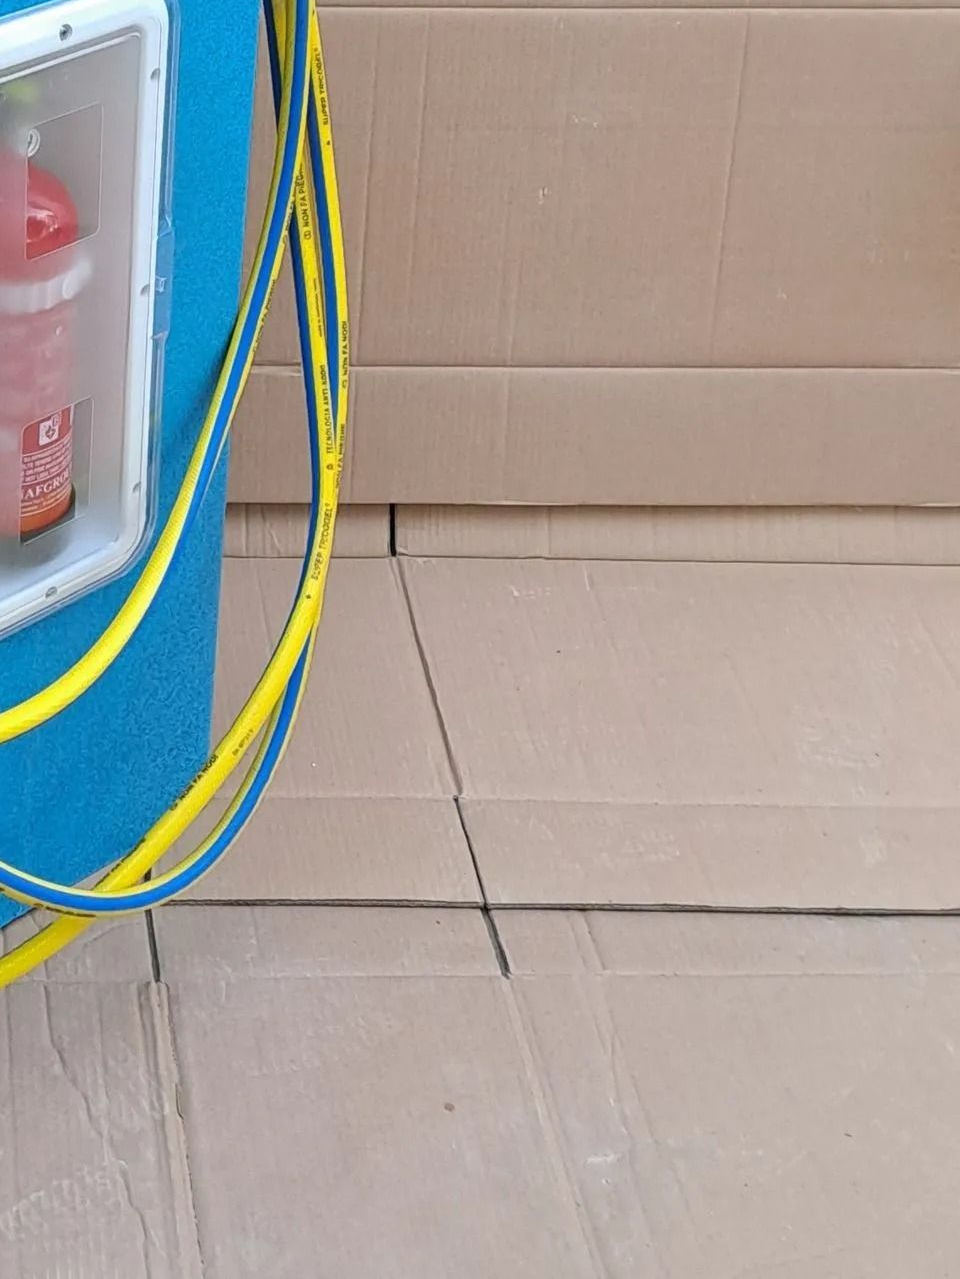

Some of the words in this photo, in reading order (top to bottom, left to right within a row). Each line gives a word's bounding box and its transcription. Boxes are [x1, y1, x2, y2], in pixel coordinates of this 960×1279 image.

[300, 195, 308, 207] FA
[302, 208, 310, 227] NON
[324, 408, 334, 454] TECNOLOGIA
